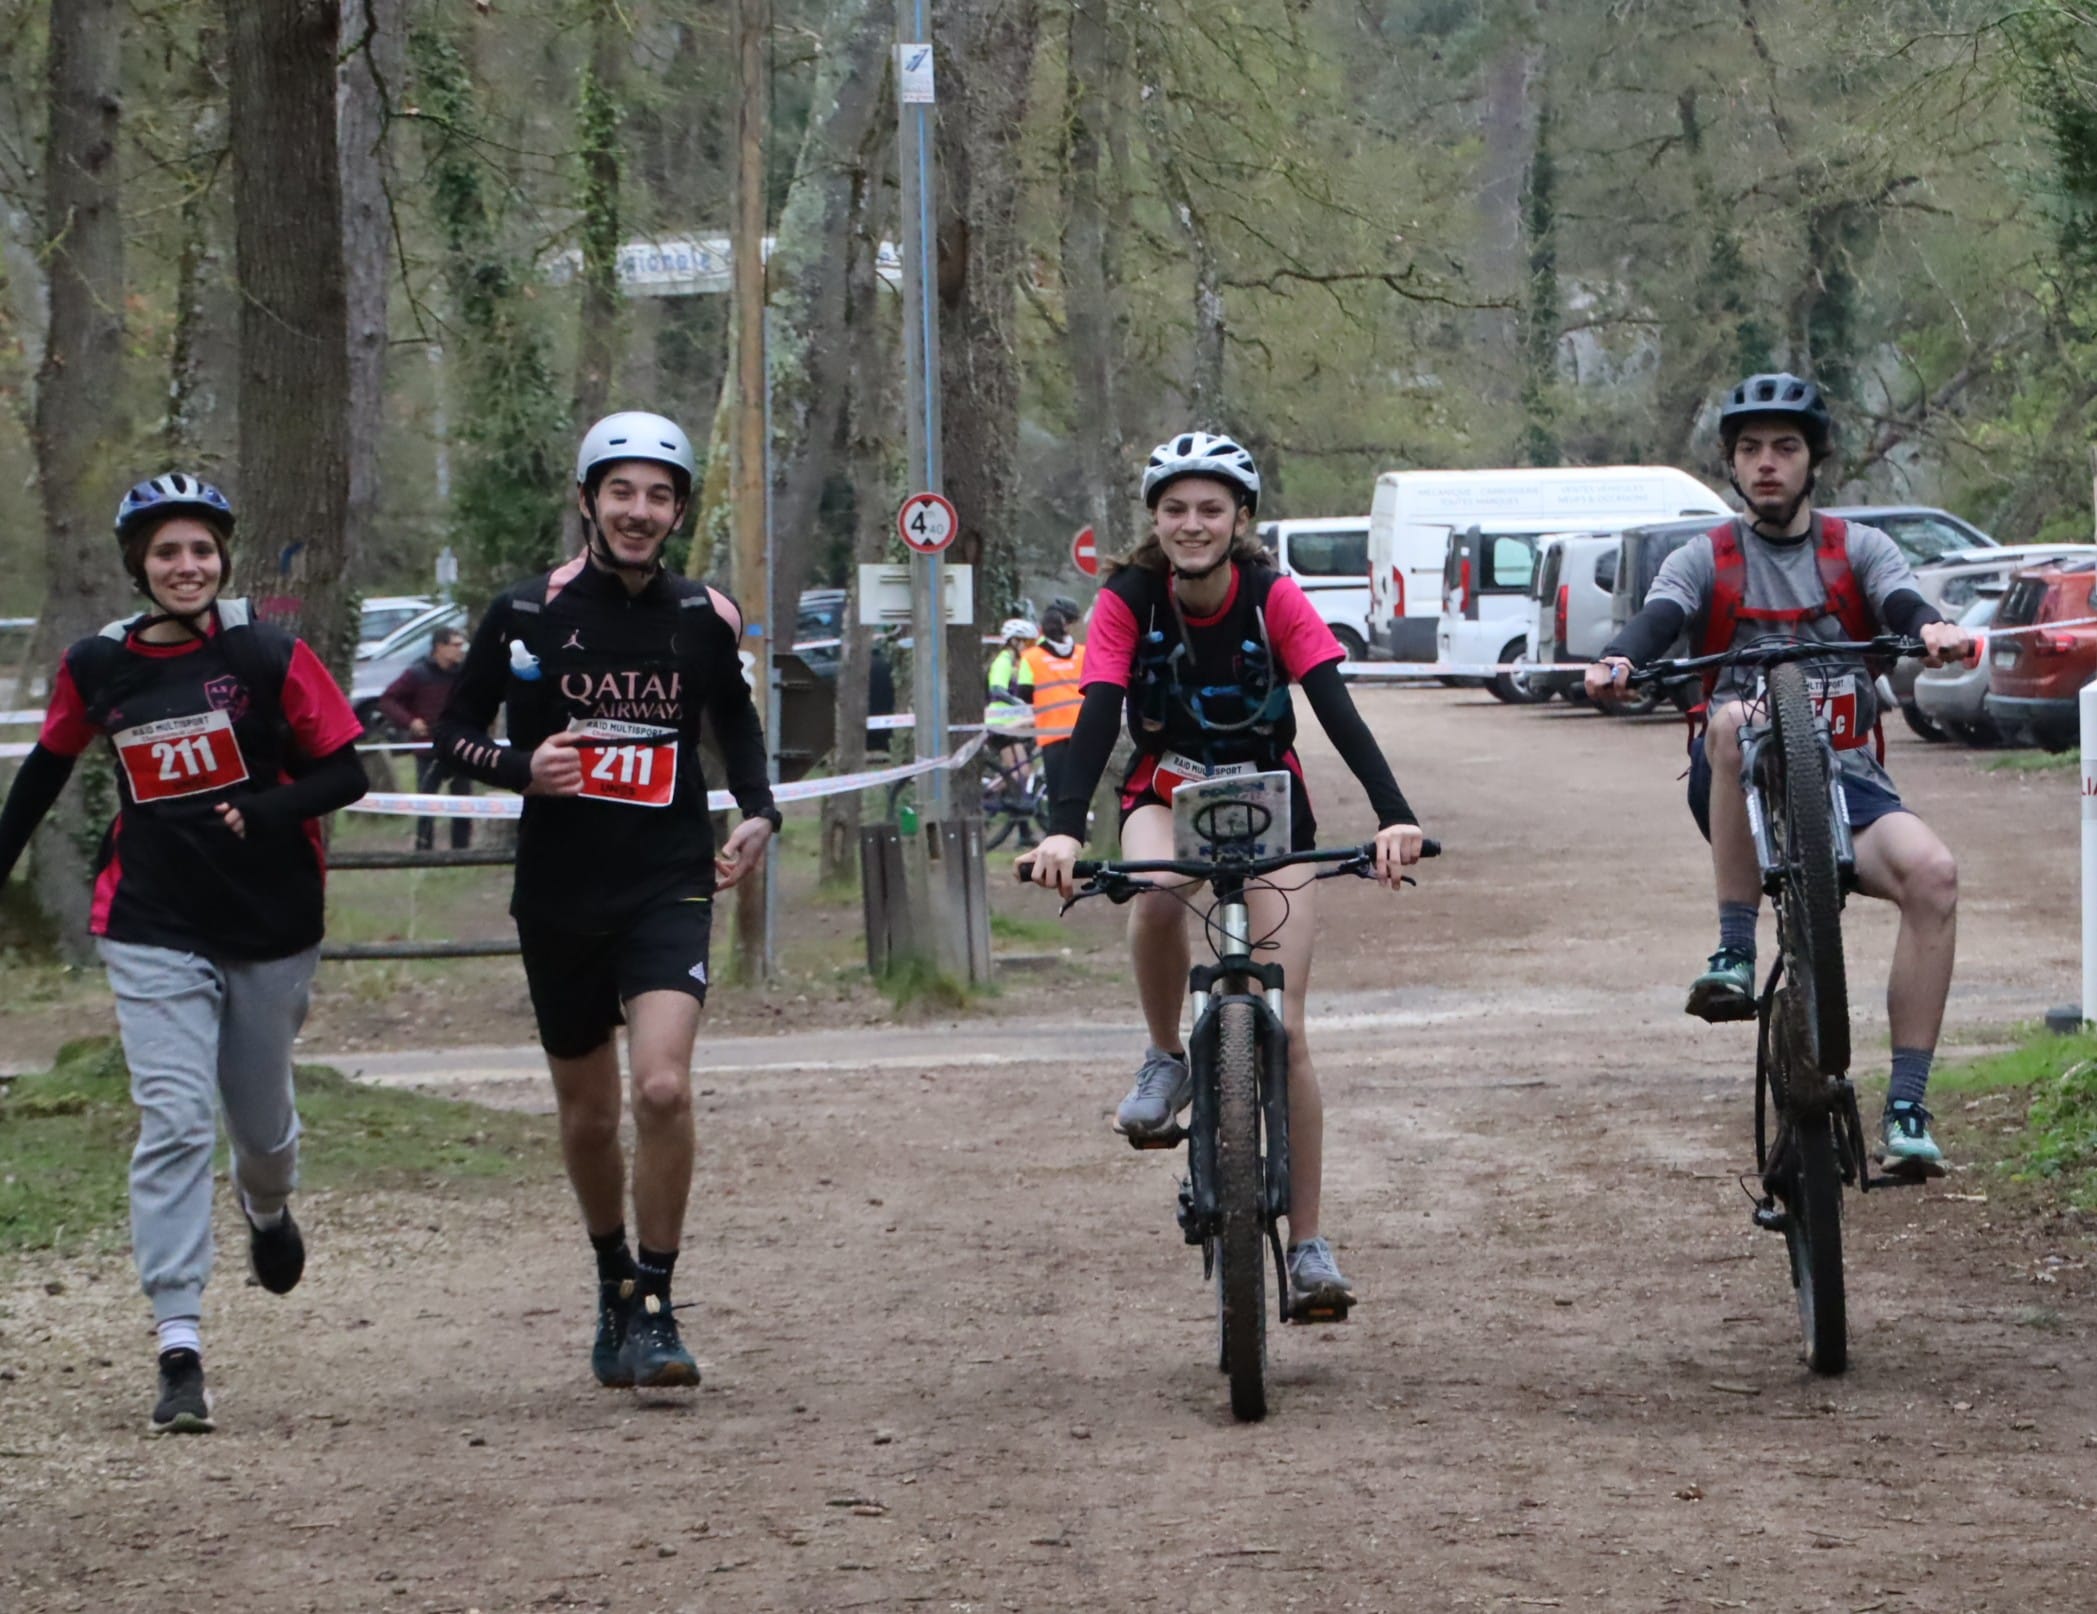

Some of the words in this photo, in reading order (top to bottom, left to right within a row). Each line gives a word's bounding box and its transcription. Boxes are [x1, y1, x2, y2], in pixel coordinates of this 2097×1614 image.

[911, 511, 927, 535] 4
[929, 523, 945, 535] 40
[609, 724, 663, 737] MULTISPORT
[151, 735, 218, 782] 211
[591, 745, 653, 785] 211
[1173, 756, 1191, 770] RAID
